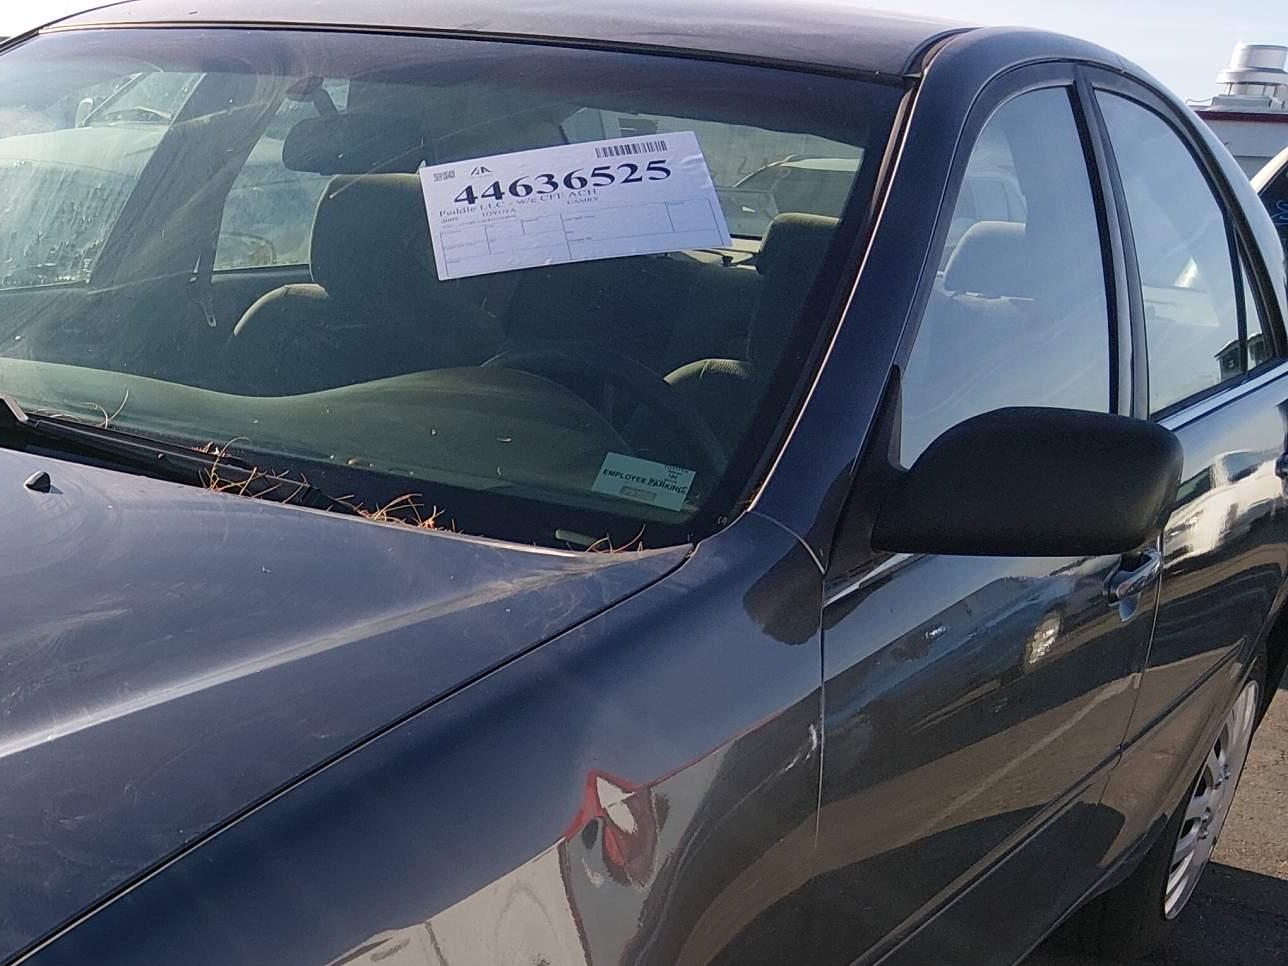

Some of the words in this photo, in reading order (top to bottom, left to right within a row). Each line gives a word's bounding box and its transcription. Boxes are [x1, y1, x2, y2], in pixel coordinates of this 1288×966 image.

[453, 159, 672, 205] 44636525
[602, 468, 647, 484] EMPLOYEE
[647, 477, 688, 495] PARKING
